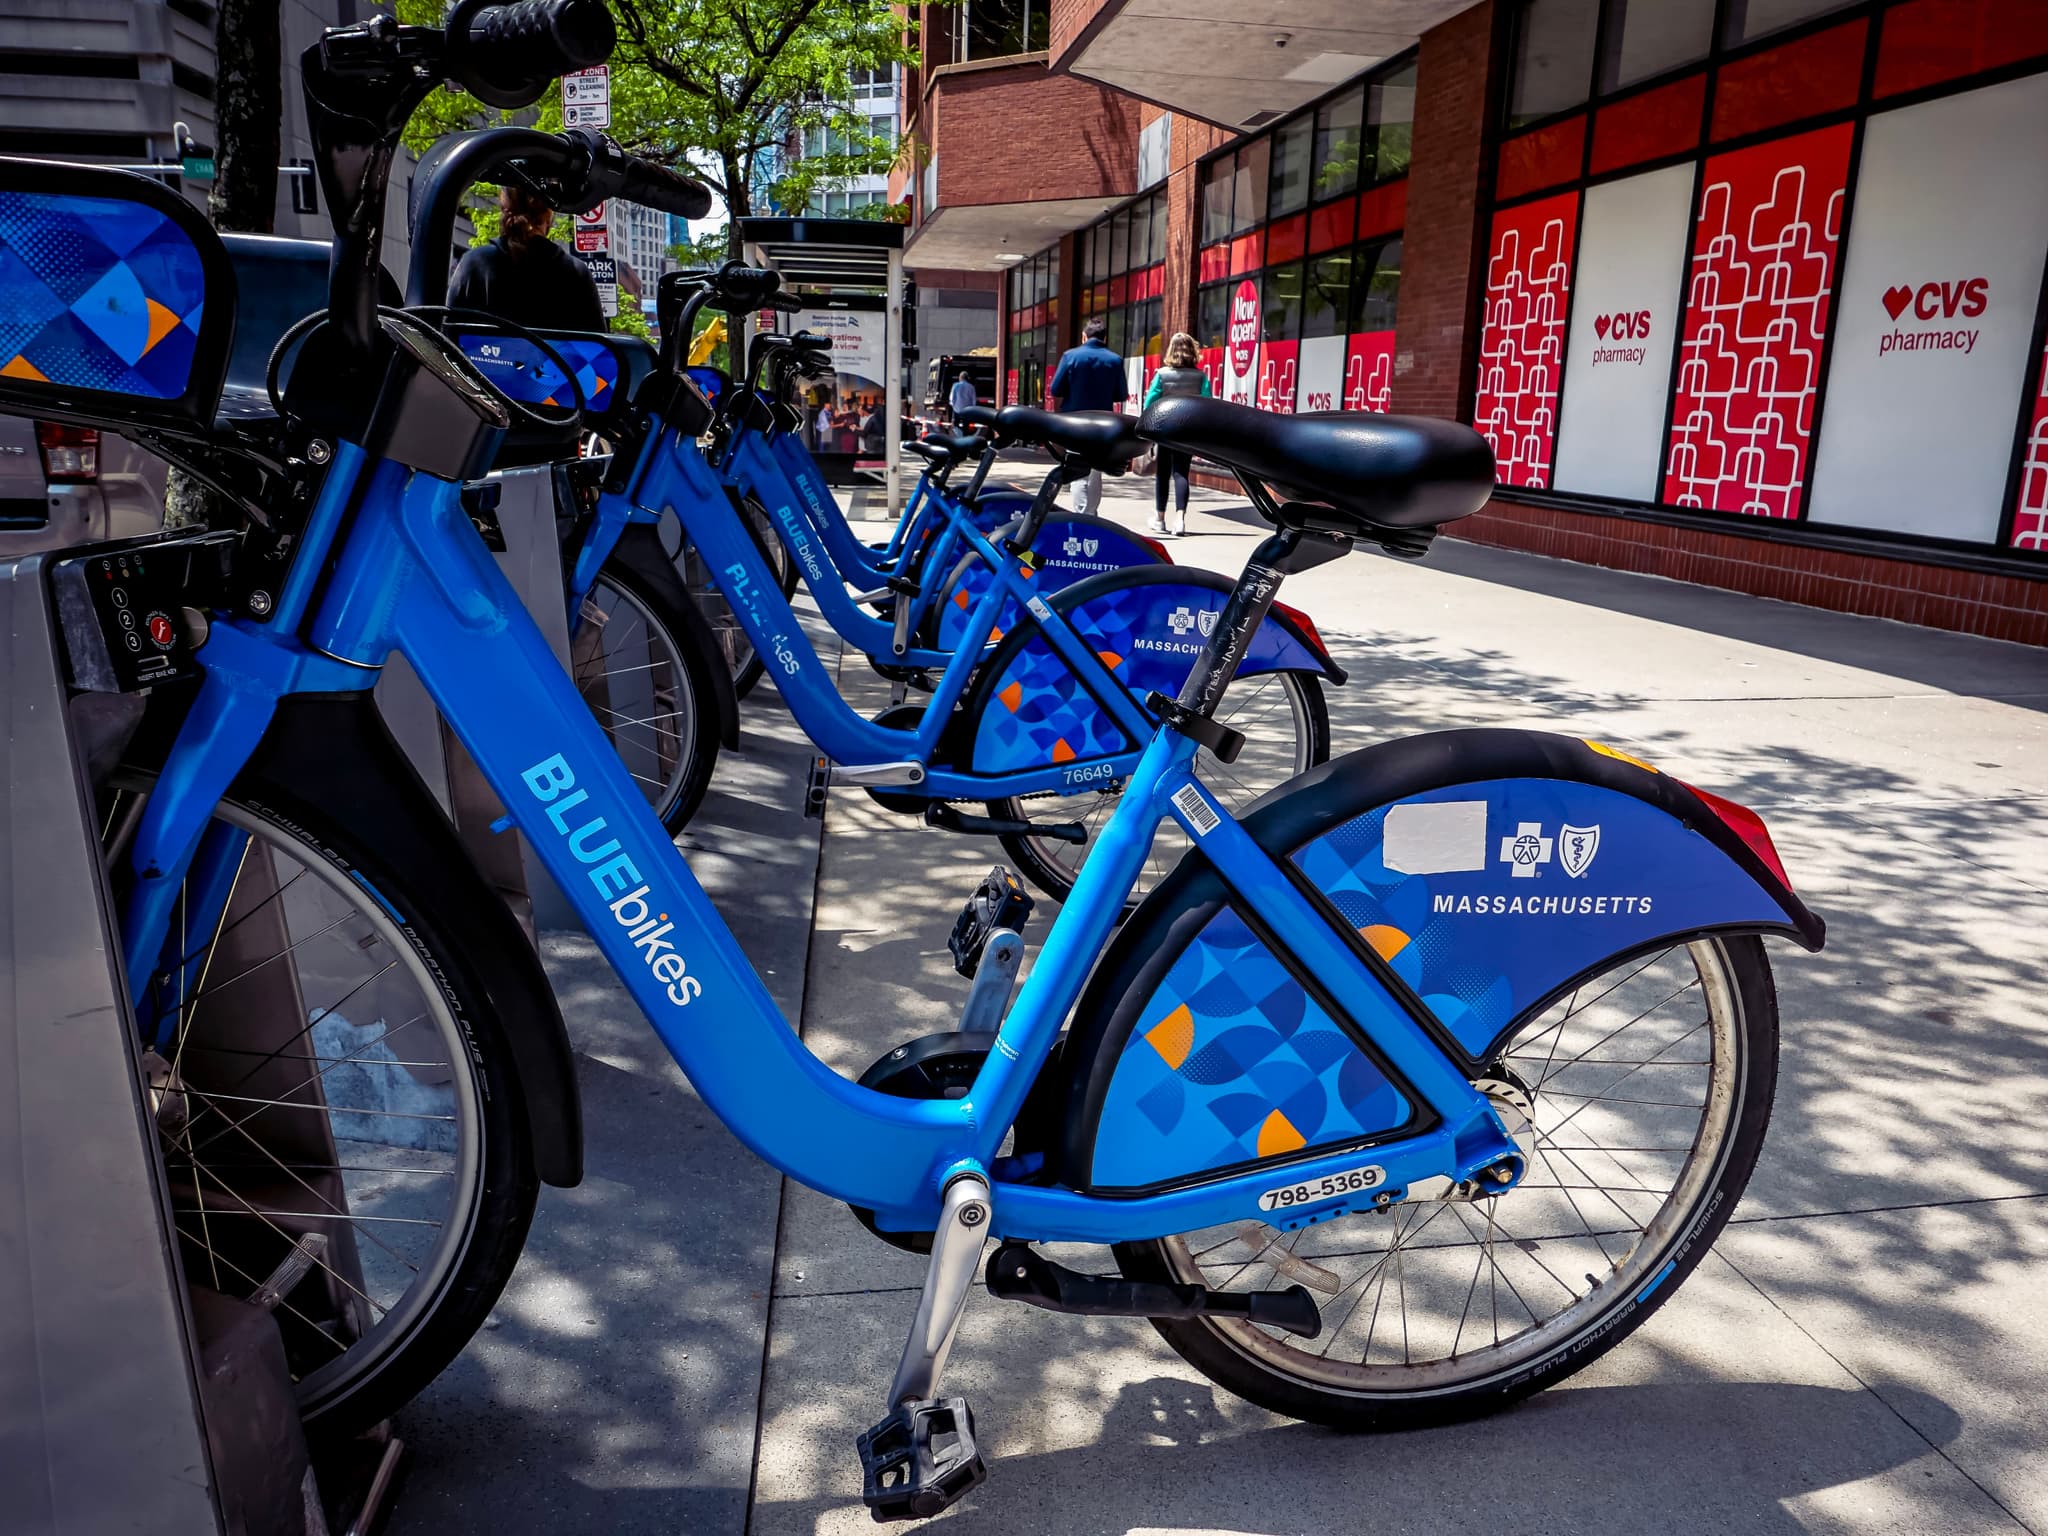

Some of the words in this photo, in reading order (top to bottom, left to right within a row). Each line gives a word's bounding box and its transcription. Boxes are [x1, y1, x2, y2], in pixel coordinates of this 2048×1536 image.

[584, 67, 606, 76] ZONE
[584, 261, 613, 272] ARK
[592, 271, 614, 279] STON
[1235, 297, 1257, 321] Now
[1914, 278, 1989, 321] CVS
[1230, 316, 1257, 348] open!
[1611, 310, 1651, 341] CVS
[1592, 345, 1647, 368] pharmacy
[1879, 328, 1980, 357] pharmacy
[1314, 392, 1332, 410] CVS
[795, 473, 830, 529] BLUEbikes
[777, 505, 823, 581] BLUEbikes
[155, 669, 168, 678] BIKE
[167, 667, 177, 675] KEY
[1063, 764, 1113, 785] 76649
[520, 752, 702, 1007] BLUEbikes
[1432, 894, 1653, 915] MASSACHUSETTS
[404, 927, 463, 1011] MARATHON
[460, 1019, 484, 1064] PLUS
[1266, 1169, 1377, 1209] 798-5369
[1675, 1189, 1724, 1262] SCHWALBE
[1572, 1301, 1637, 1354] MARATHON
[1534, 1354, 1568, 1377] PLUS
